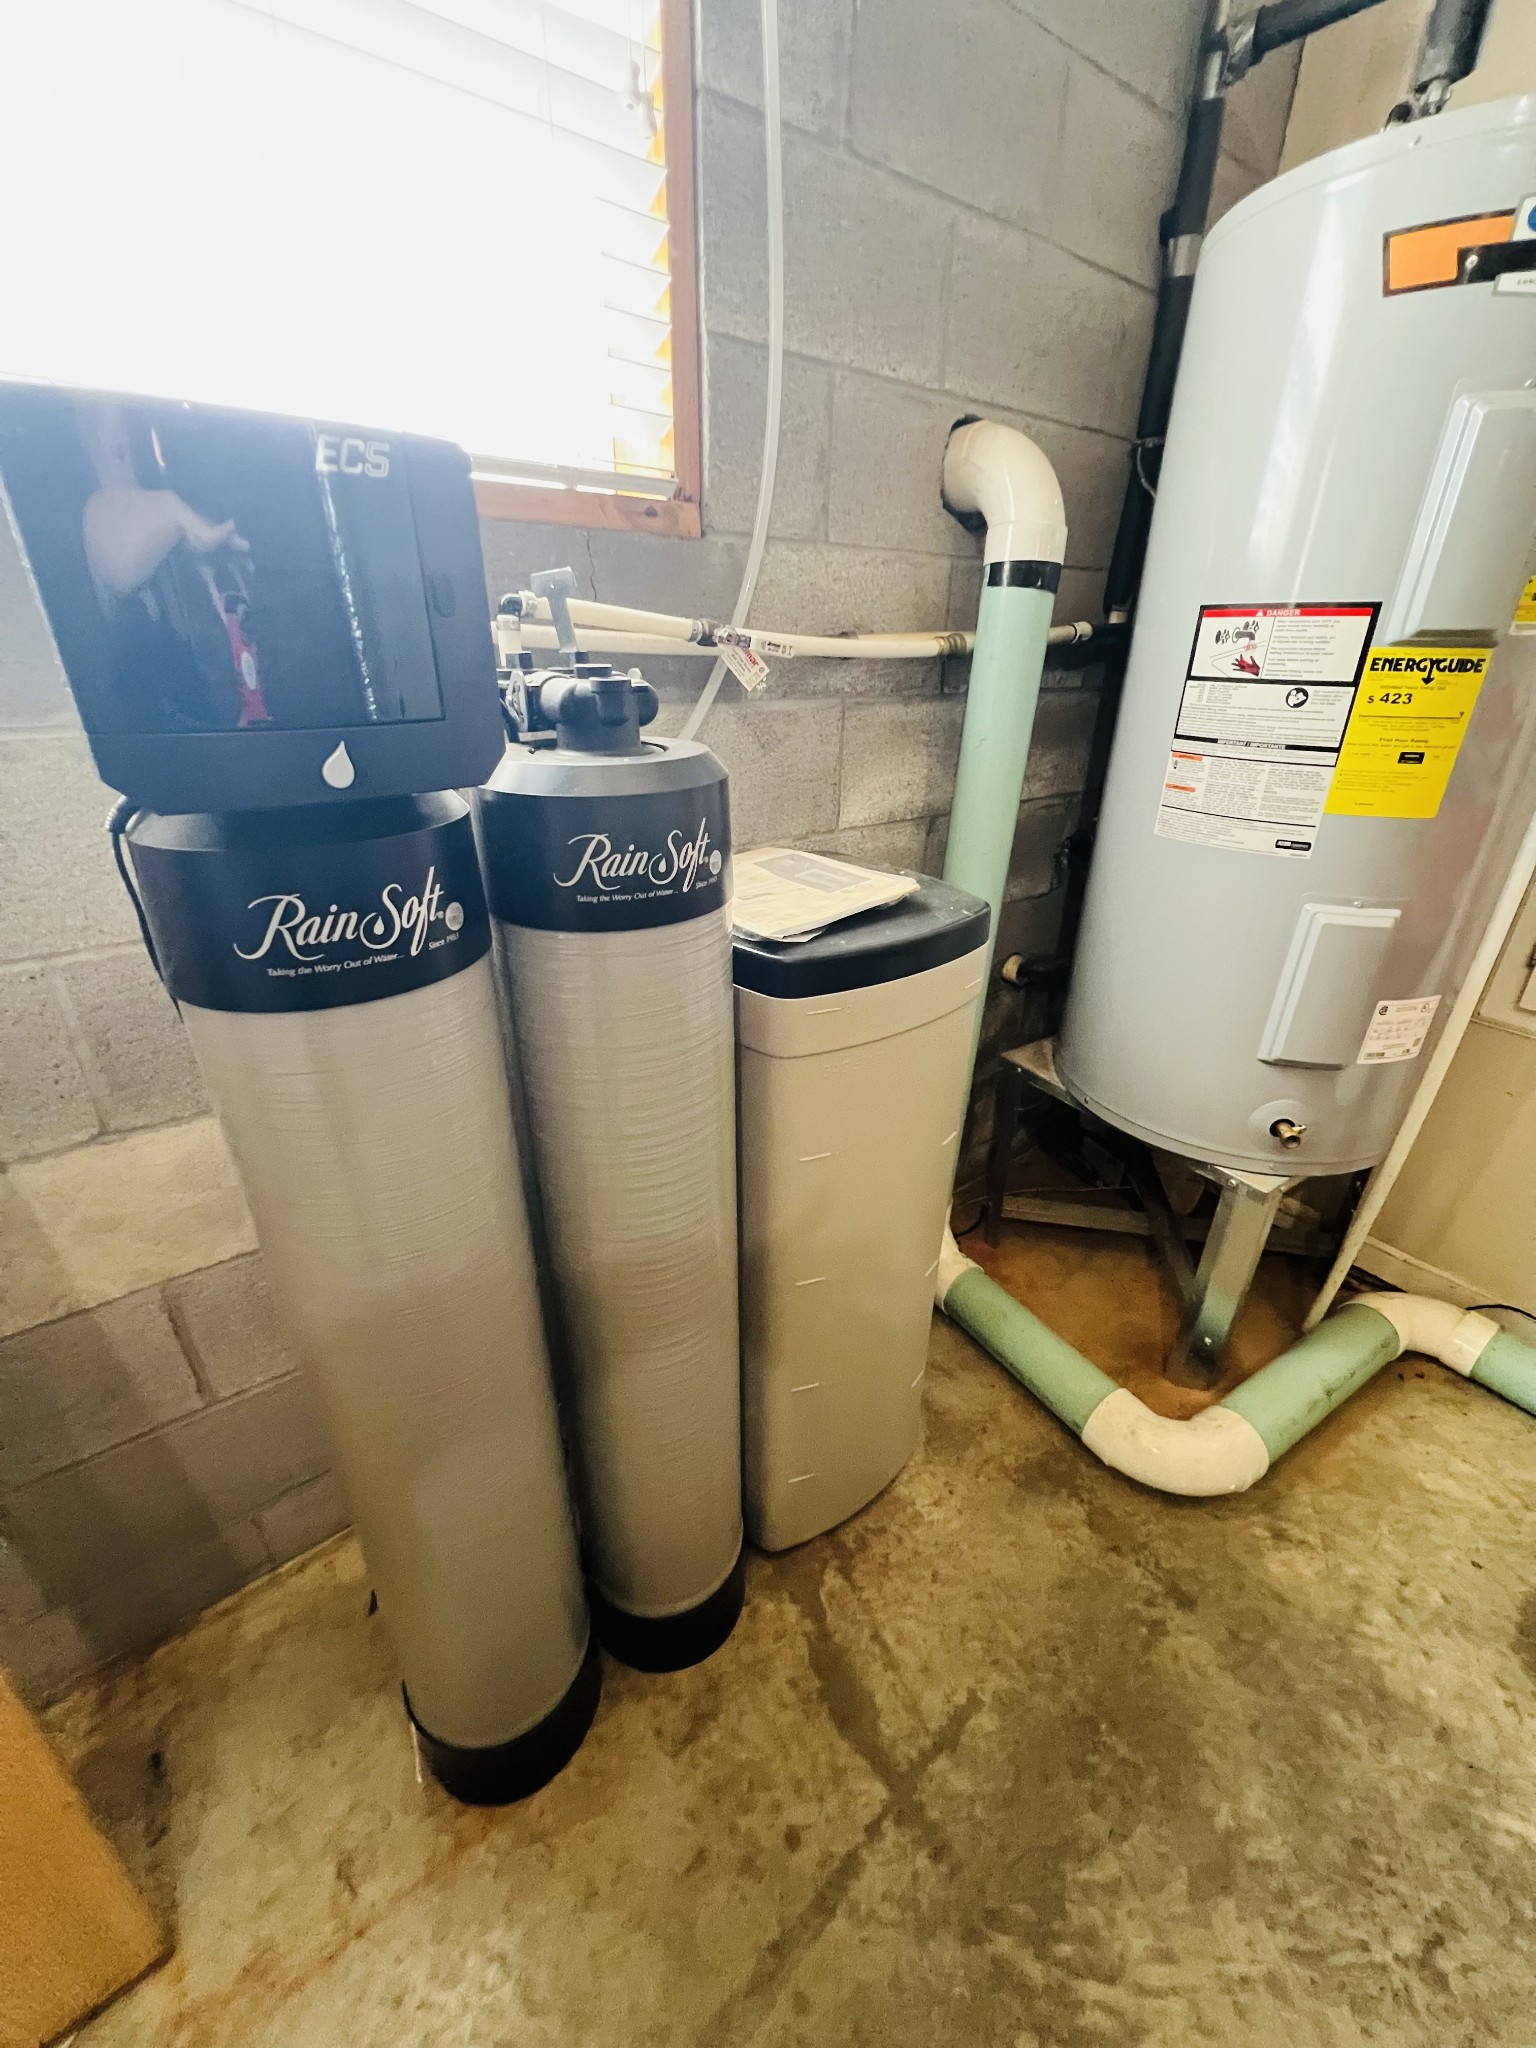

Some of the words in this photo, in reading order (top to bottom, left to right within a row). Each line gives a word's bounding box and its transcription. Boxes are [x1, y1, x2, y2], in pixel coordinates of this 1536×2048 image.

[1379, 692, 1413, 705] 423
[576, 894, 599, 904] Taking
[600, 894, 610, 902] the
[634, 892, 647, 900] Out
[648, 889, 656, 898] of
[266, 968, 296, 978] Taking
[298, 966, 313, 975] the
[314, 963, 342, 973] Worry
[344, 960, 361, 969] Out
[363, 956, 373, 966] of
